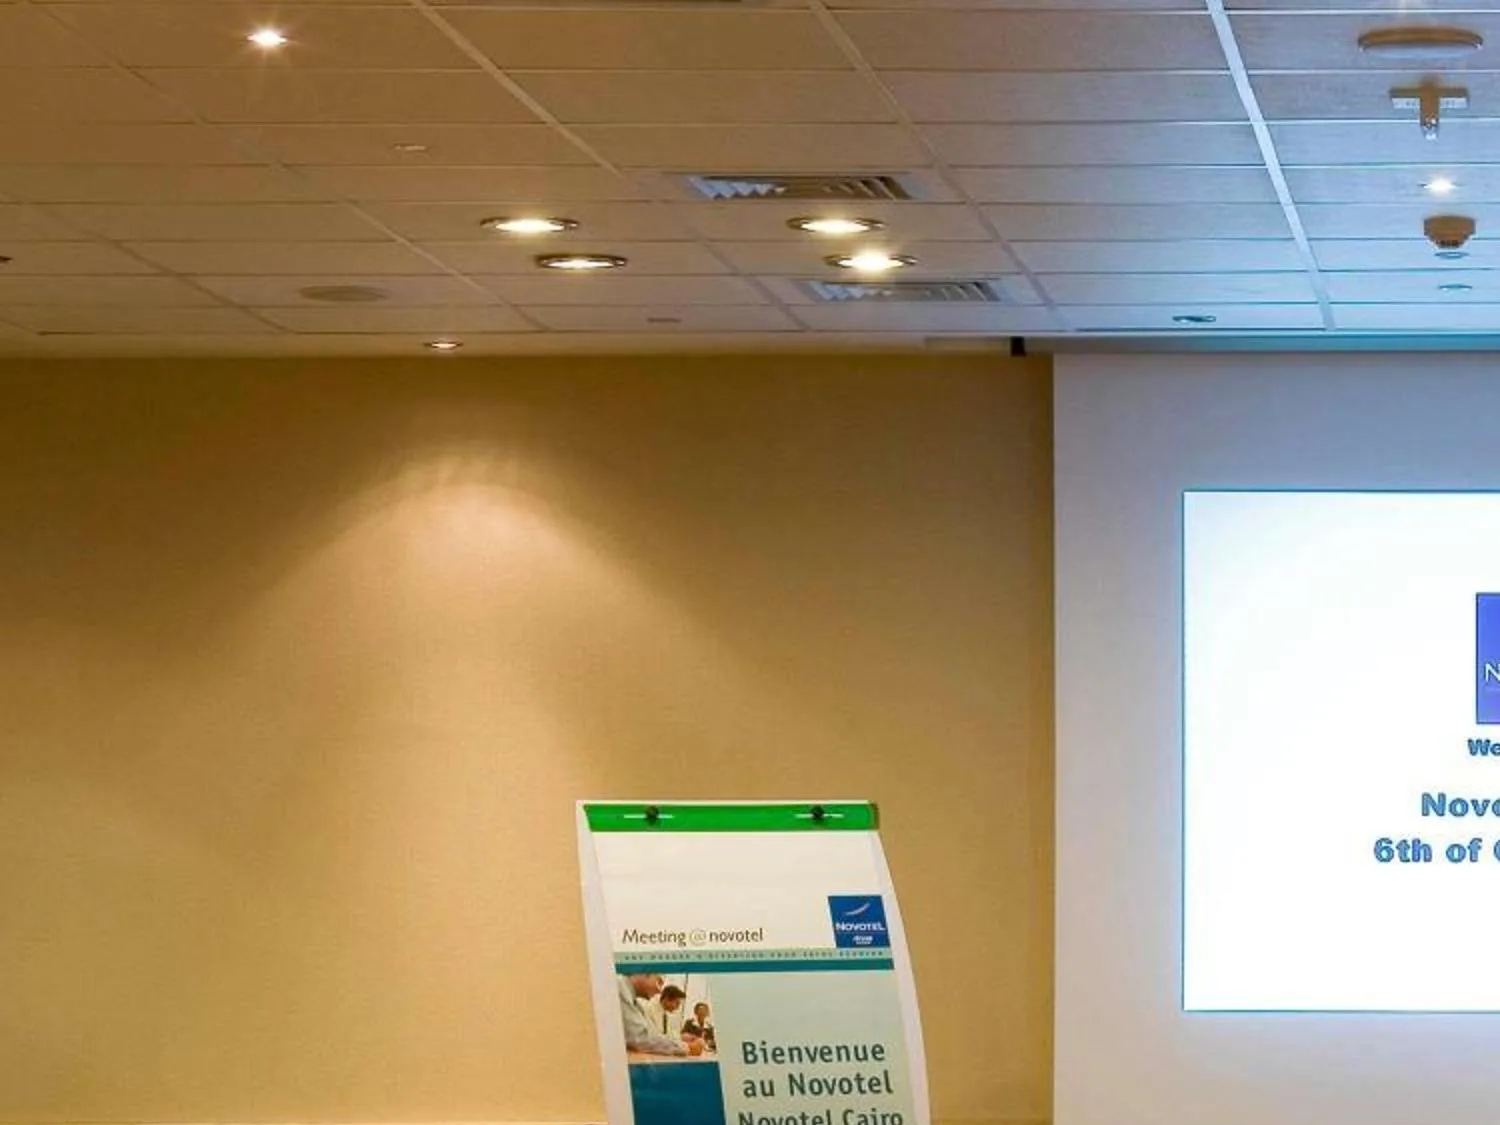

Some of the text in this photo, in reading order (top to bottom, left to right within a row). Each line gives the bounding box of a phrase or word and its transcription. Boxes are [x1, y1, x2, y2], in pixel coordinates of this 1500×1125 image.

[1373, 838, 1433, 864] 6th
[1445, 838, 1483, 864] of
[741, 1041, 886, 1065] Bienvenue
[743, 1069, 895, 1098] au Novotel
